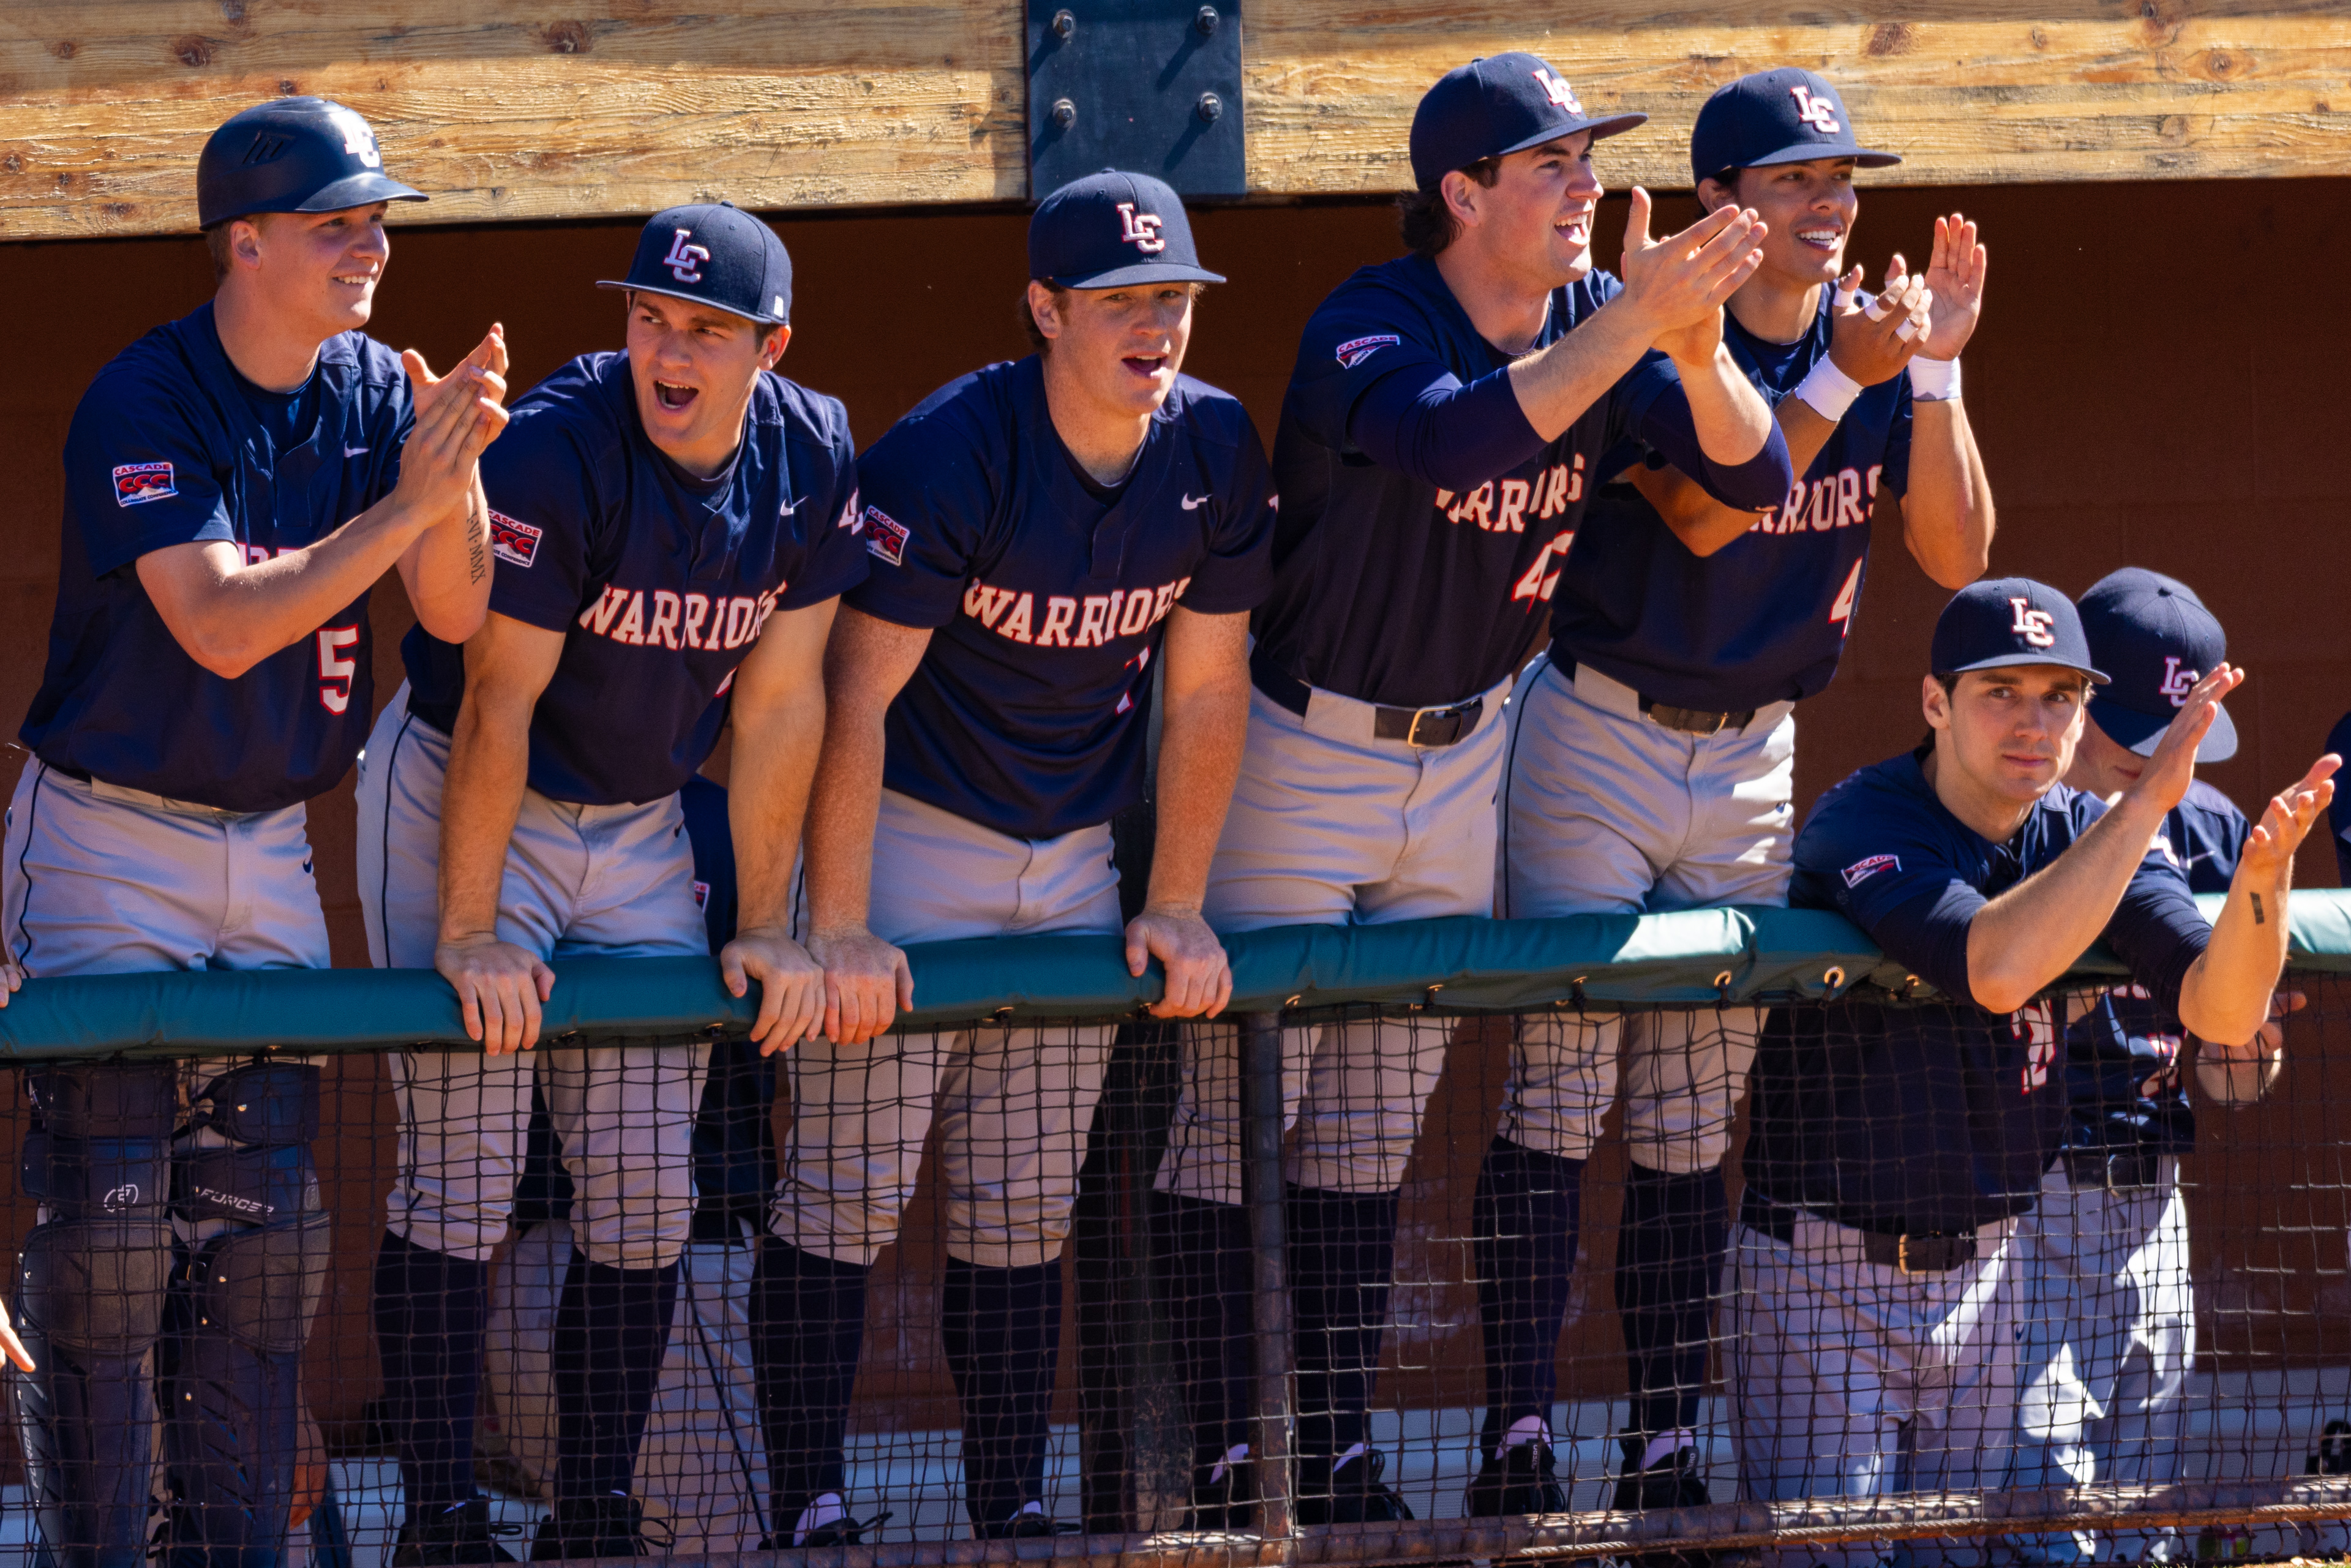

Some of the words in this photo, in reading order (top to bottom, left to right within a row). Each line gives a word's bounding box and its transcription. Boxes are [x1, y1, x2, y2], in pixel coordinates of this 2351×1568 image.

[1532, 68, 1582, 115] LC
[1790, 85, 1840, 133] LC
[329, 113, 380, 168] LC
[1115, 202, 1166, 253] LC
[662, 228, 710, 283] LC
[1338, 336, 1397, 353] CASCADE
[114, 463, 171, 476] CASCADE
[118, 473, 170, 493] CCC
[868, 507, 907, 537] CASCADE
[2009, 598, 2055, 648] LC
[316, 623, 360, 716] 5
[2159, 656, 2199, 708] LC
